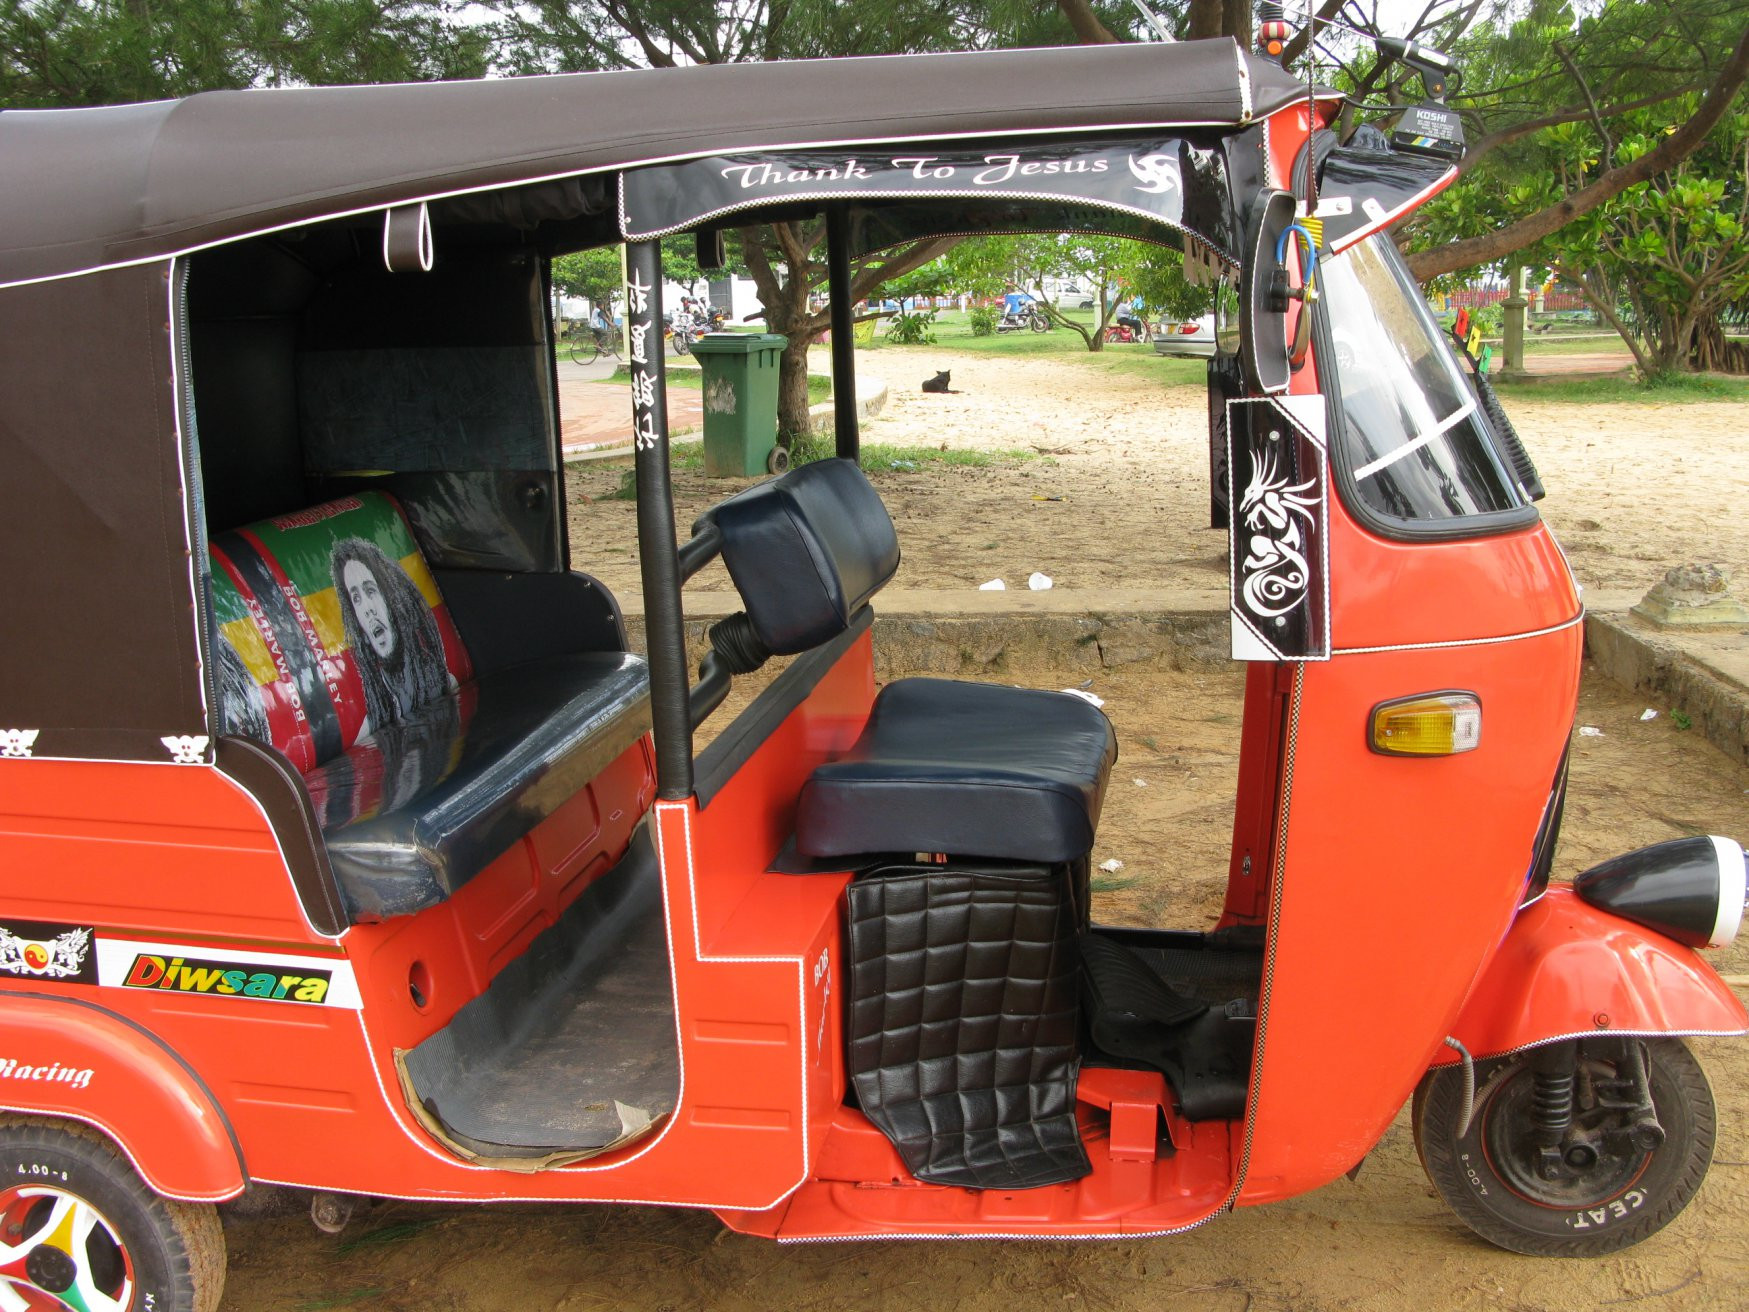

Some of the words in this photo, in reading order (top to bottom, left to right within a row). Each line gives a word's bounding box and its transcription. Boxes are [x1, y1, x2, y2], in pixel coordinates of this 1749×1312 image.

[1416, 110, 1447, 123] KOSHI
[721, 160, 872, 188] Thank
[891, 157, 955, 178] To
[973, 154, 1109, 185] Jesus
[247, 598, 289, 674] MARLEY
[283, 585, 307, 622] BOB
[305, 628, 342, 703] MARLEY
[286, 681, 305, 721] BOB
[126, 954, 328, 1002] Diwsara
[814, 947, 829, 988] BOB
[0, 1058, 95, 1089] Racing
[1573, 1190, 1643, 1228] CEAT
